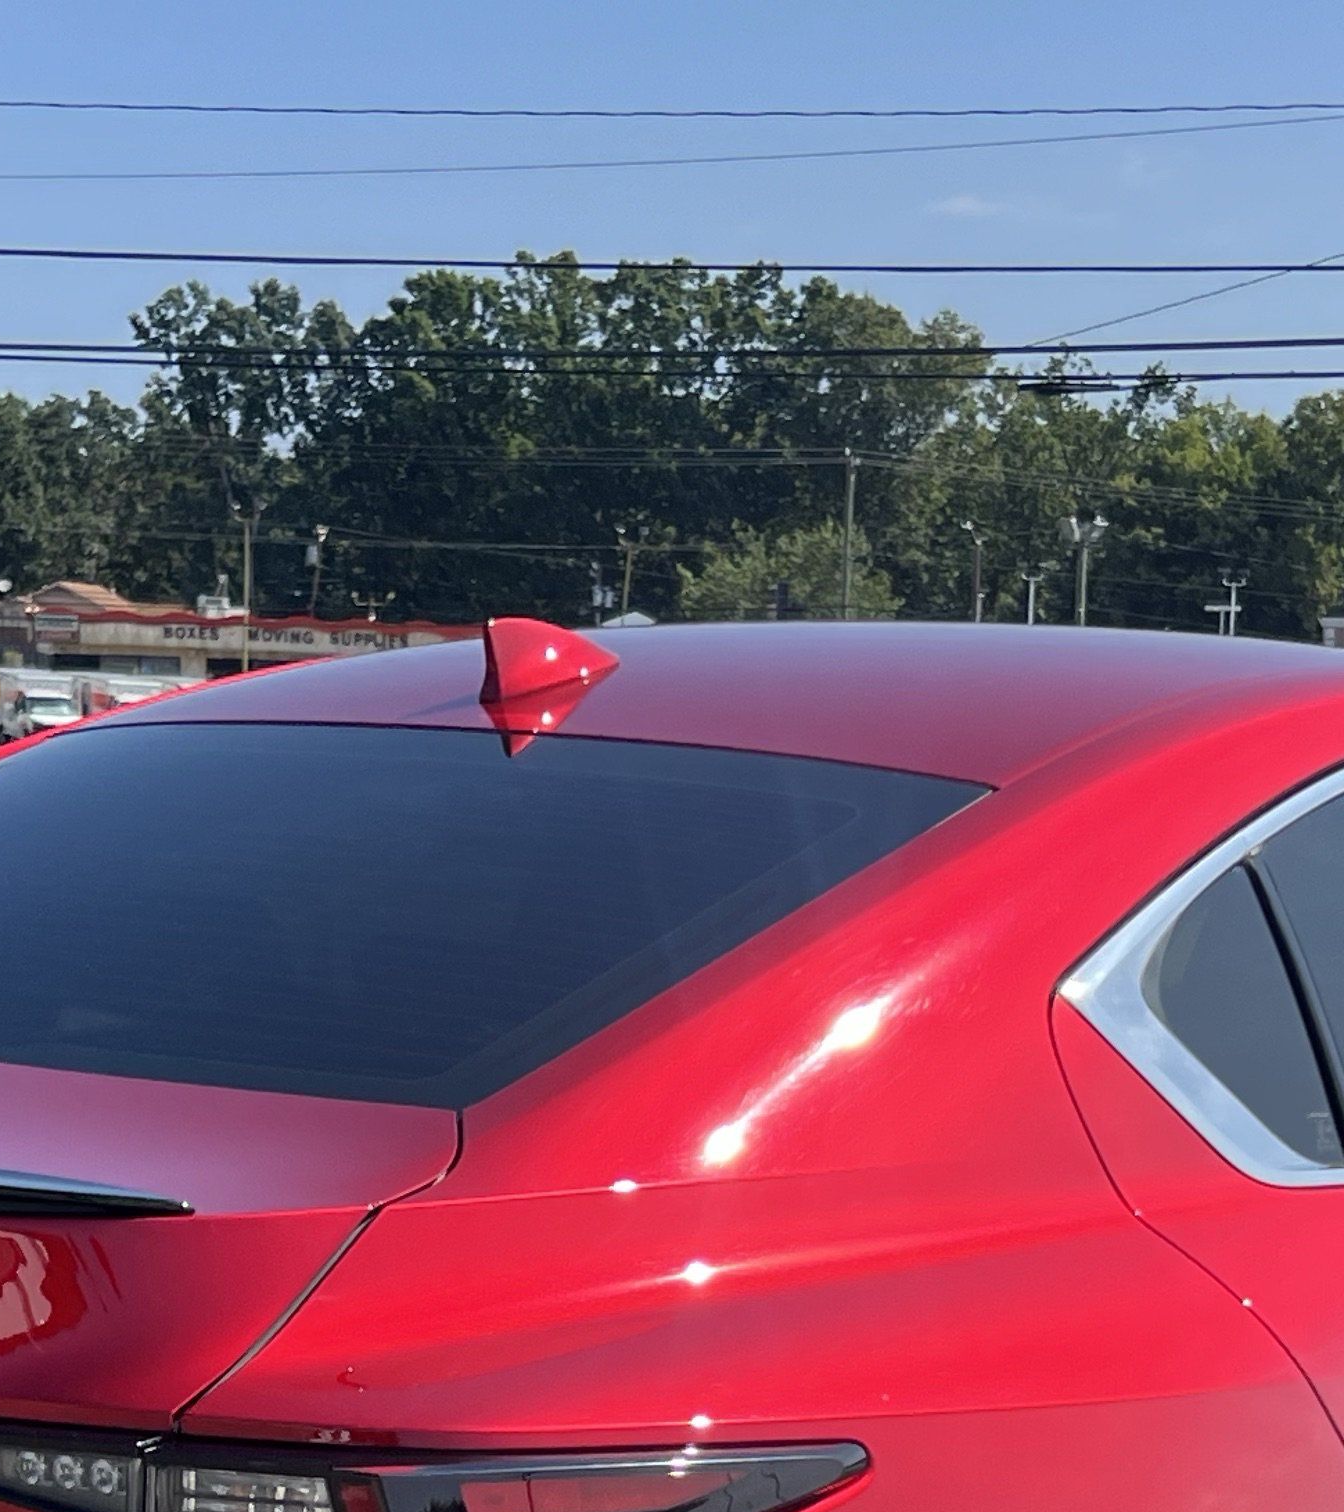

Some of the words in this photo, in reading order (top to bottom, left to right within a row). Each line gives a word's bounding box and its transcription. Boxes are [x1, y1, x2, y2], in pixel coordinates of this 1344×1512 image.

[163, 626, 220, 641] BOXES
[248, 628, 315, 644] MOVING
[328, 631, 409, 648] SUPPLIES
